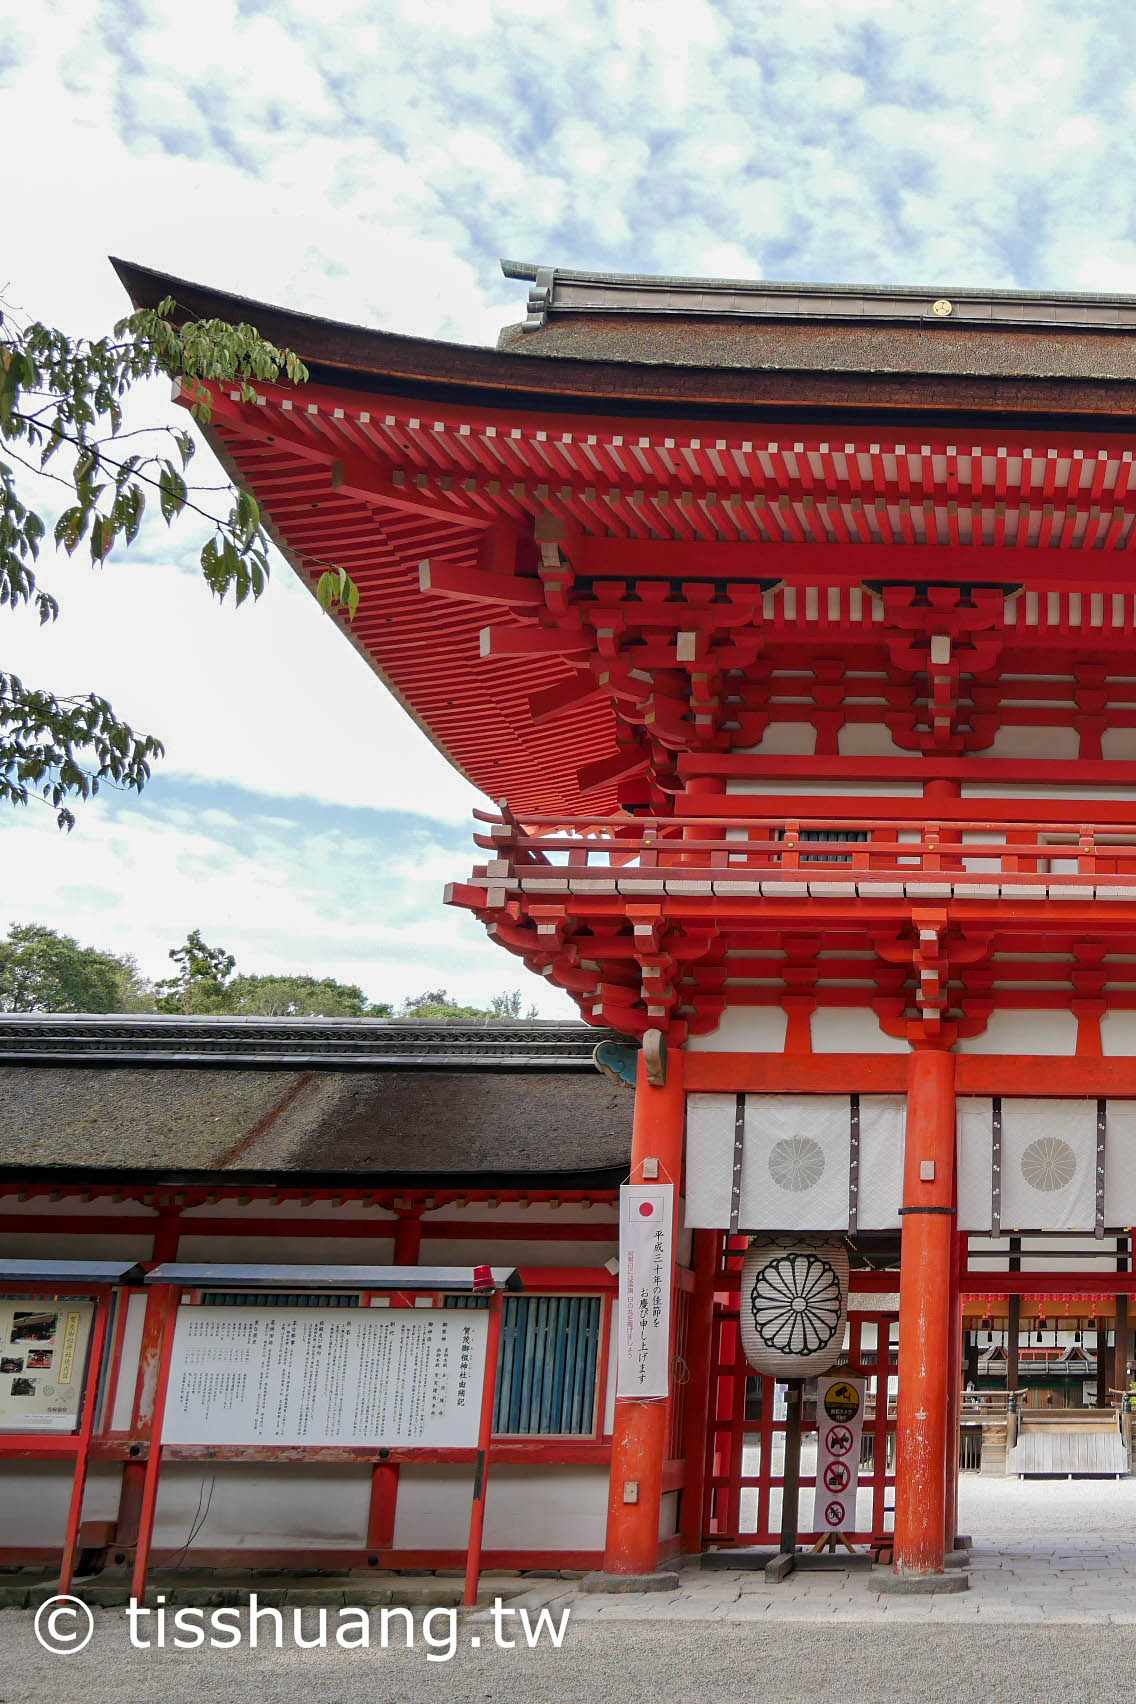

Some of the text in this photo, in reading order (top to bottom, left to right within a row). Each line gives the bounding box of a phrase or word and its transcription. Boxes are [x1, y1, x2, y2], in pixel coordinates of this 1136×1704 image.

[652, 1230, 665, 1328] 平成三十年の佳節を
[637, 1288, 650, 1385] お慶び申し上げます
